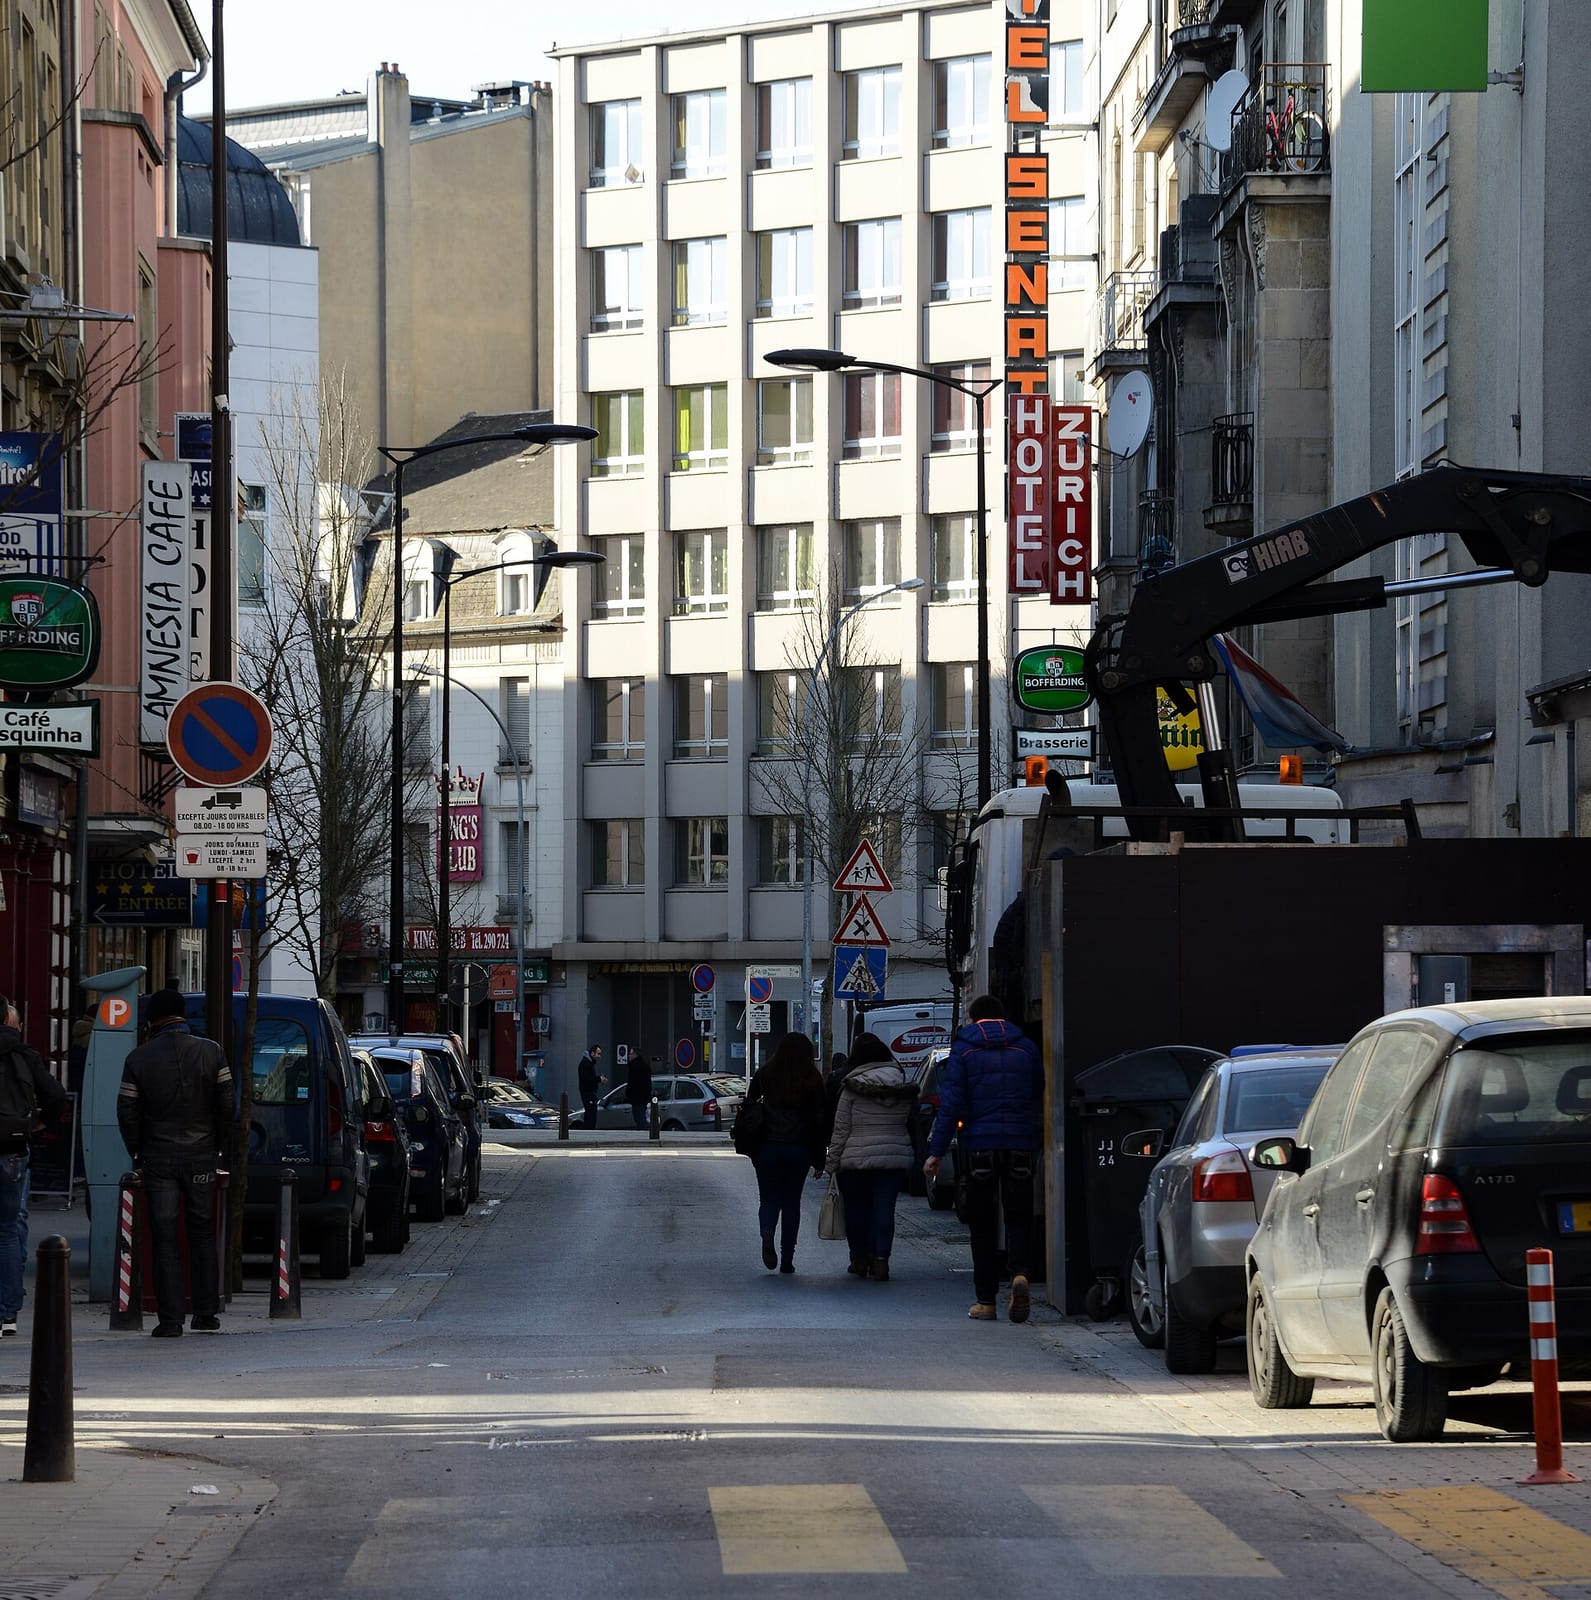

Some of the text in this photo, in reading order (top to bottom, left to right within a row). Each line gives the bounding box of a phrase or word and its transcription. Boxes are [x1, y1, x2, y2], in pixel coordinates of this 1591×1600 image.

[1016, 399, 1043, 588] HOTEL
[1057, 412, 1085, 598] ZURICH
[1252, 529, 1310, 572] HIAB
[143, 479, 186, 721] AMNESIA CAFE
[1024, 677, 1085, 688] BOFFERDING
[5, 711, 50, 727] Café
[0, 727, 82, 745] squinha
[1019, 736, 1089, 749] Brasserie
[206, 813, 227, 821] JOURS
[228, 812, 265, 820] OUVRABLES
[448, 845, 477, 872] LUB
[100, 863, 178, 880] HOTEL
[118, 893, 188, 911] ENTRÉE
[109, 999, 128, 1025] P
[1475, 1174, 1516, 1185] A170
